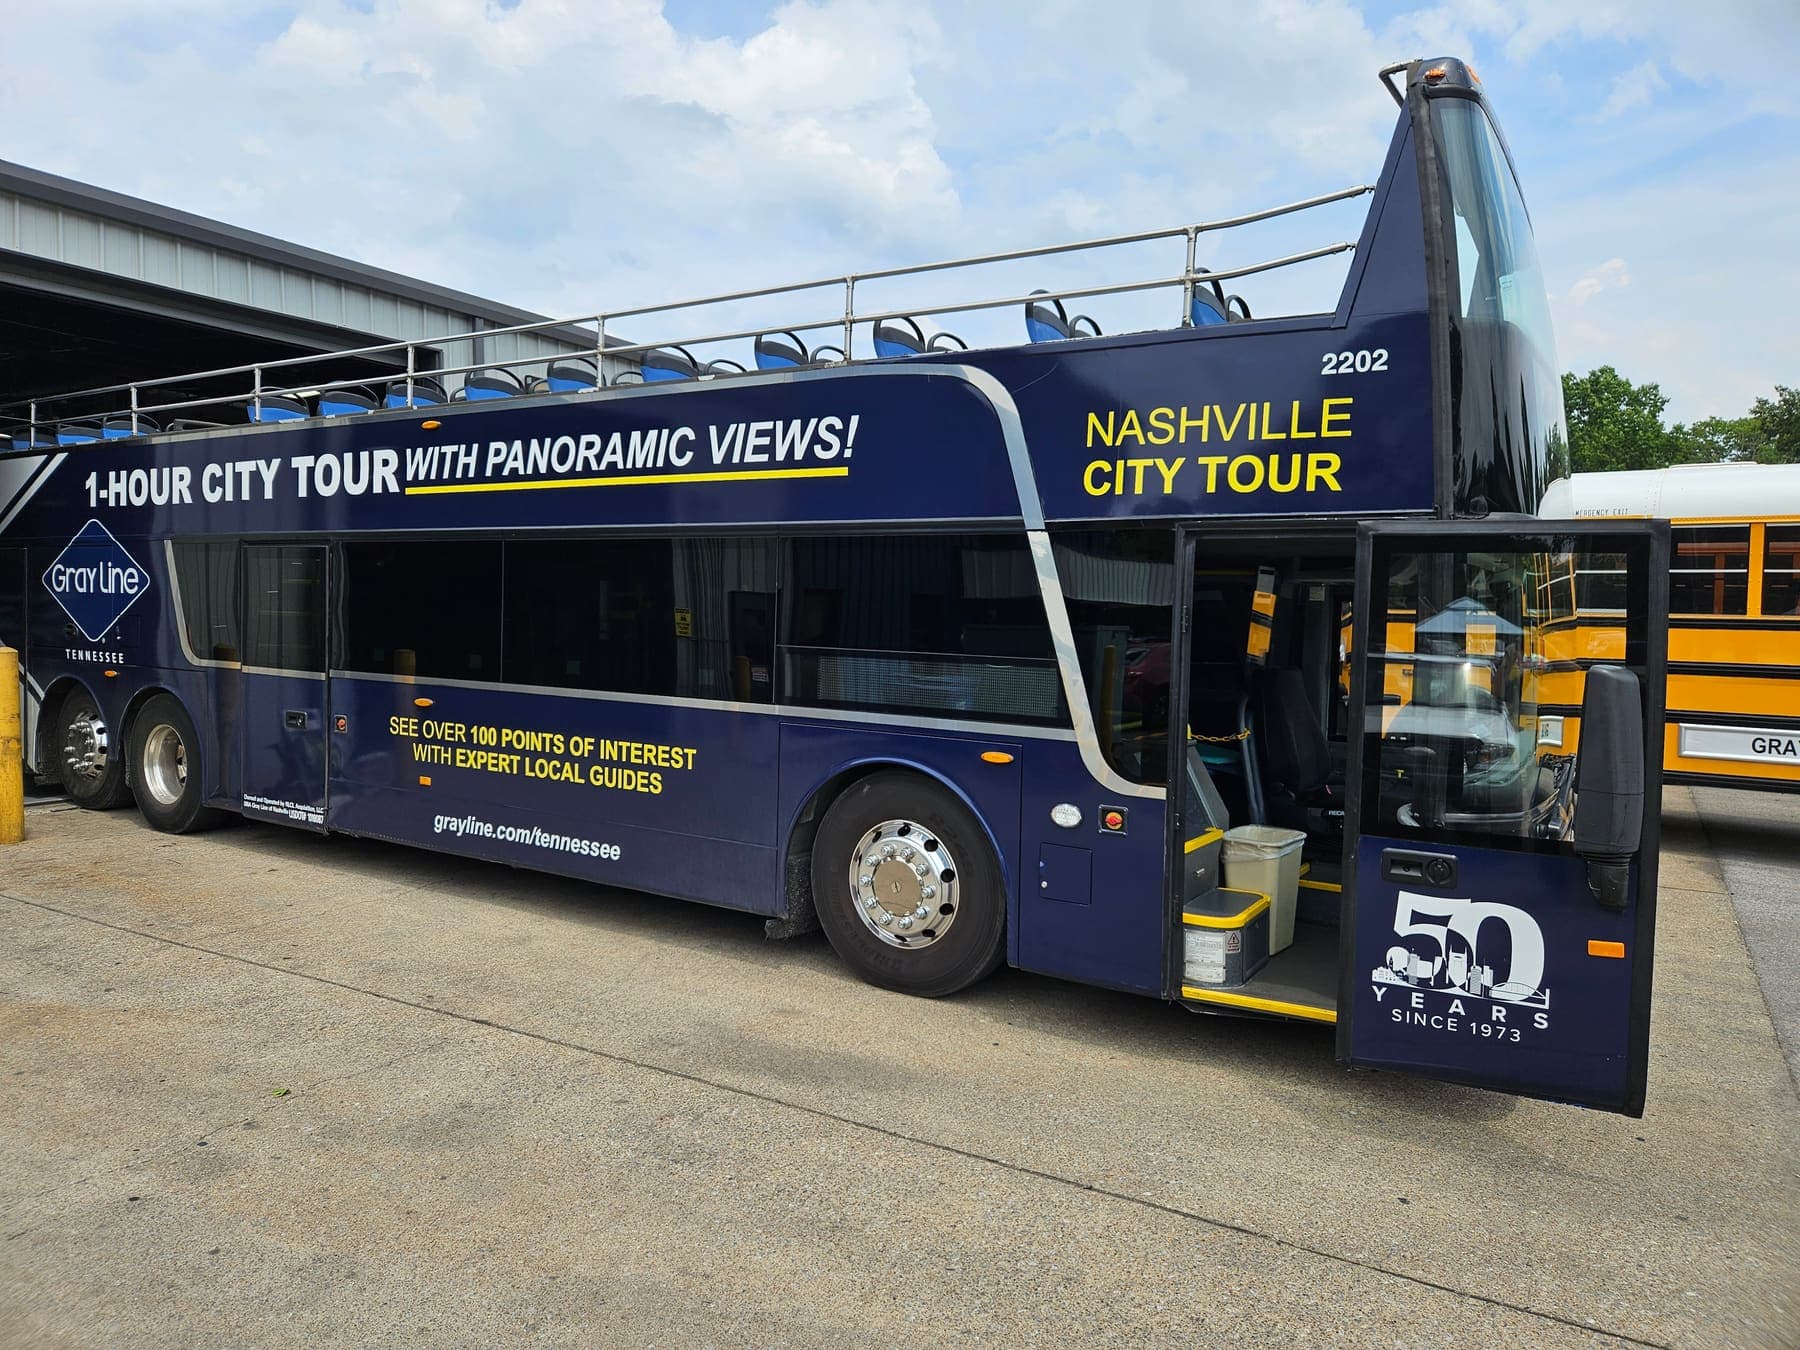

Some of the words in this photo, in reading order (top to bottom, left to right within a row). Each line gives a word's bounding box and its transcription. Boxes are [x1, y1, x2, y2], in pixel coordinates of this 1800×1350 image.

[1321, 349, 1389, 375] 2202
[1086, 397, 1353, 448] NASHVILLE
[85, 466, 193, 507] 1-HOUR
[202, 458, 282, 503] CITY
[291, 449, 400, 498] TOUR
[405, 443, 479, 481] WITH
[485, 426, 696, 477] PANORAMIC
[709, 415, 860, 465] VIEWS!
[1083, 457, 1186, 496] CITY
[1198, 452, 1342, 494] TOUR
[1575, 508, 1608, 517] MERGENCY
[65, 649, 125, 664] TENNESSEE
[390, 716, 419, 737] SEE
[422, 720, 467, 743] OVER
[470, 725, 498, 746] 100
[501, 728, 565, 754] POINTS
[569, 735, 595, 757] OF
[600, 739, 697, 770] INTEREST
[1752, 737, 1800, 756] GRA
[412, 742, 452, 765] WITH
[455, 748, 521, 774] EXPERT
[525, 757, 585, 784] LOCAL
[589, 765, 663, 795] GUIDES
[434, 814, 621, 861] grayline.com/tennessee
[1394, 890, 1545, 1001] 50
[1372, 986, 1550, 1029] YEARS
[1391, 1009, 1458, 1032] SINCE
[1470, 1022, 1521, 1042] 1973
